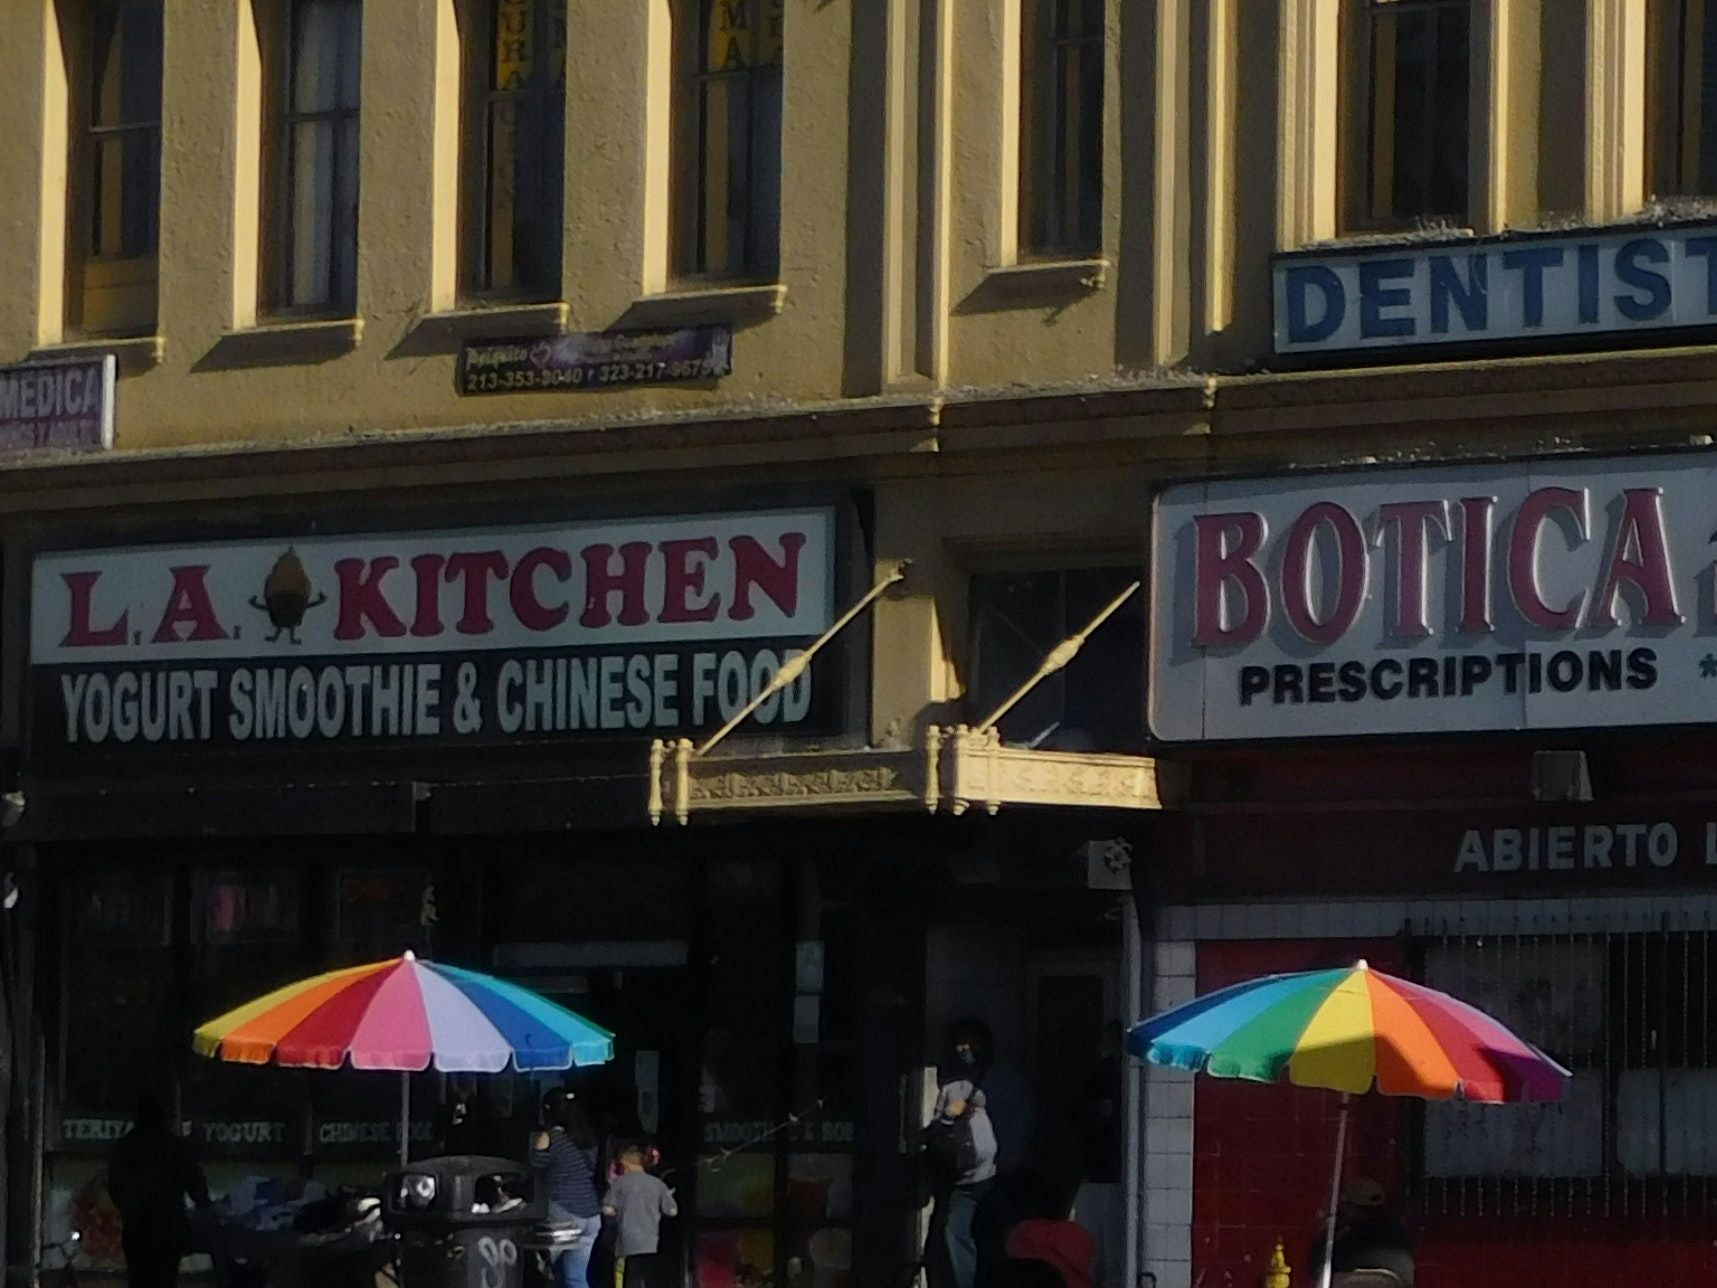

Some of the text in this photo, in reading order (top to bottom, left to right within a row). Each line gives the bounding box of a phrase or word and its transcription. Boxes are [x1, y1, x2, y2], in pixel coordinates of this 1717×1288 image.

[334, 531, 807, 643] KITCHEN
[1190, 486, 1687, 649] BOTICA
[62, 648, 813, 744] YOGURT SMOOTHIE & CHINESE FOOD
[1239, 646, 1659, 707] PRESCRIPTIONS
[1454, 821, 1679, 874] ABIERTO
[203, 1120, 287, 1144] YOGURT
